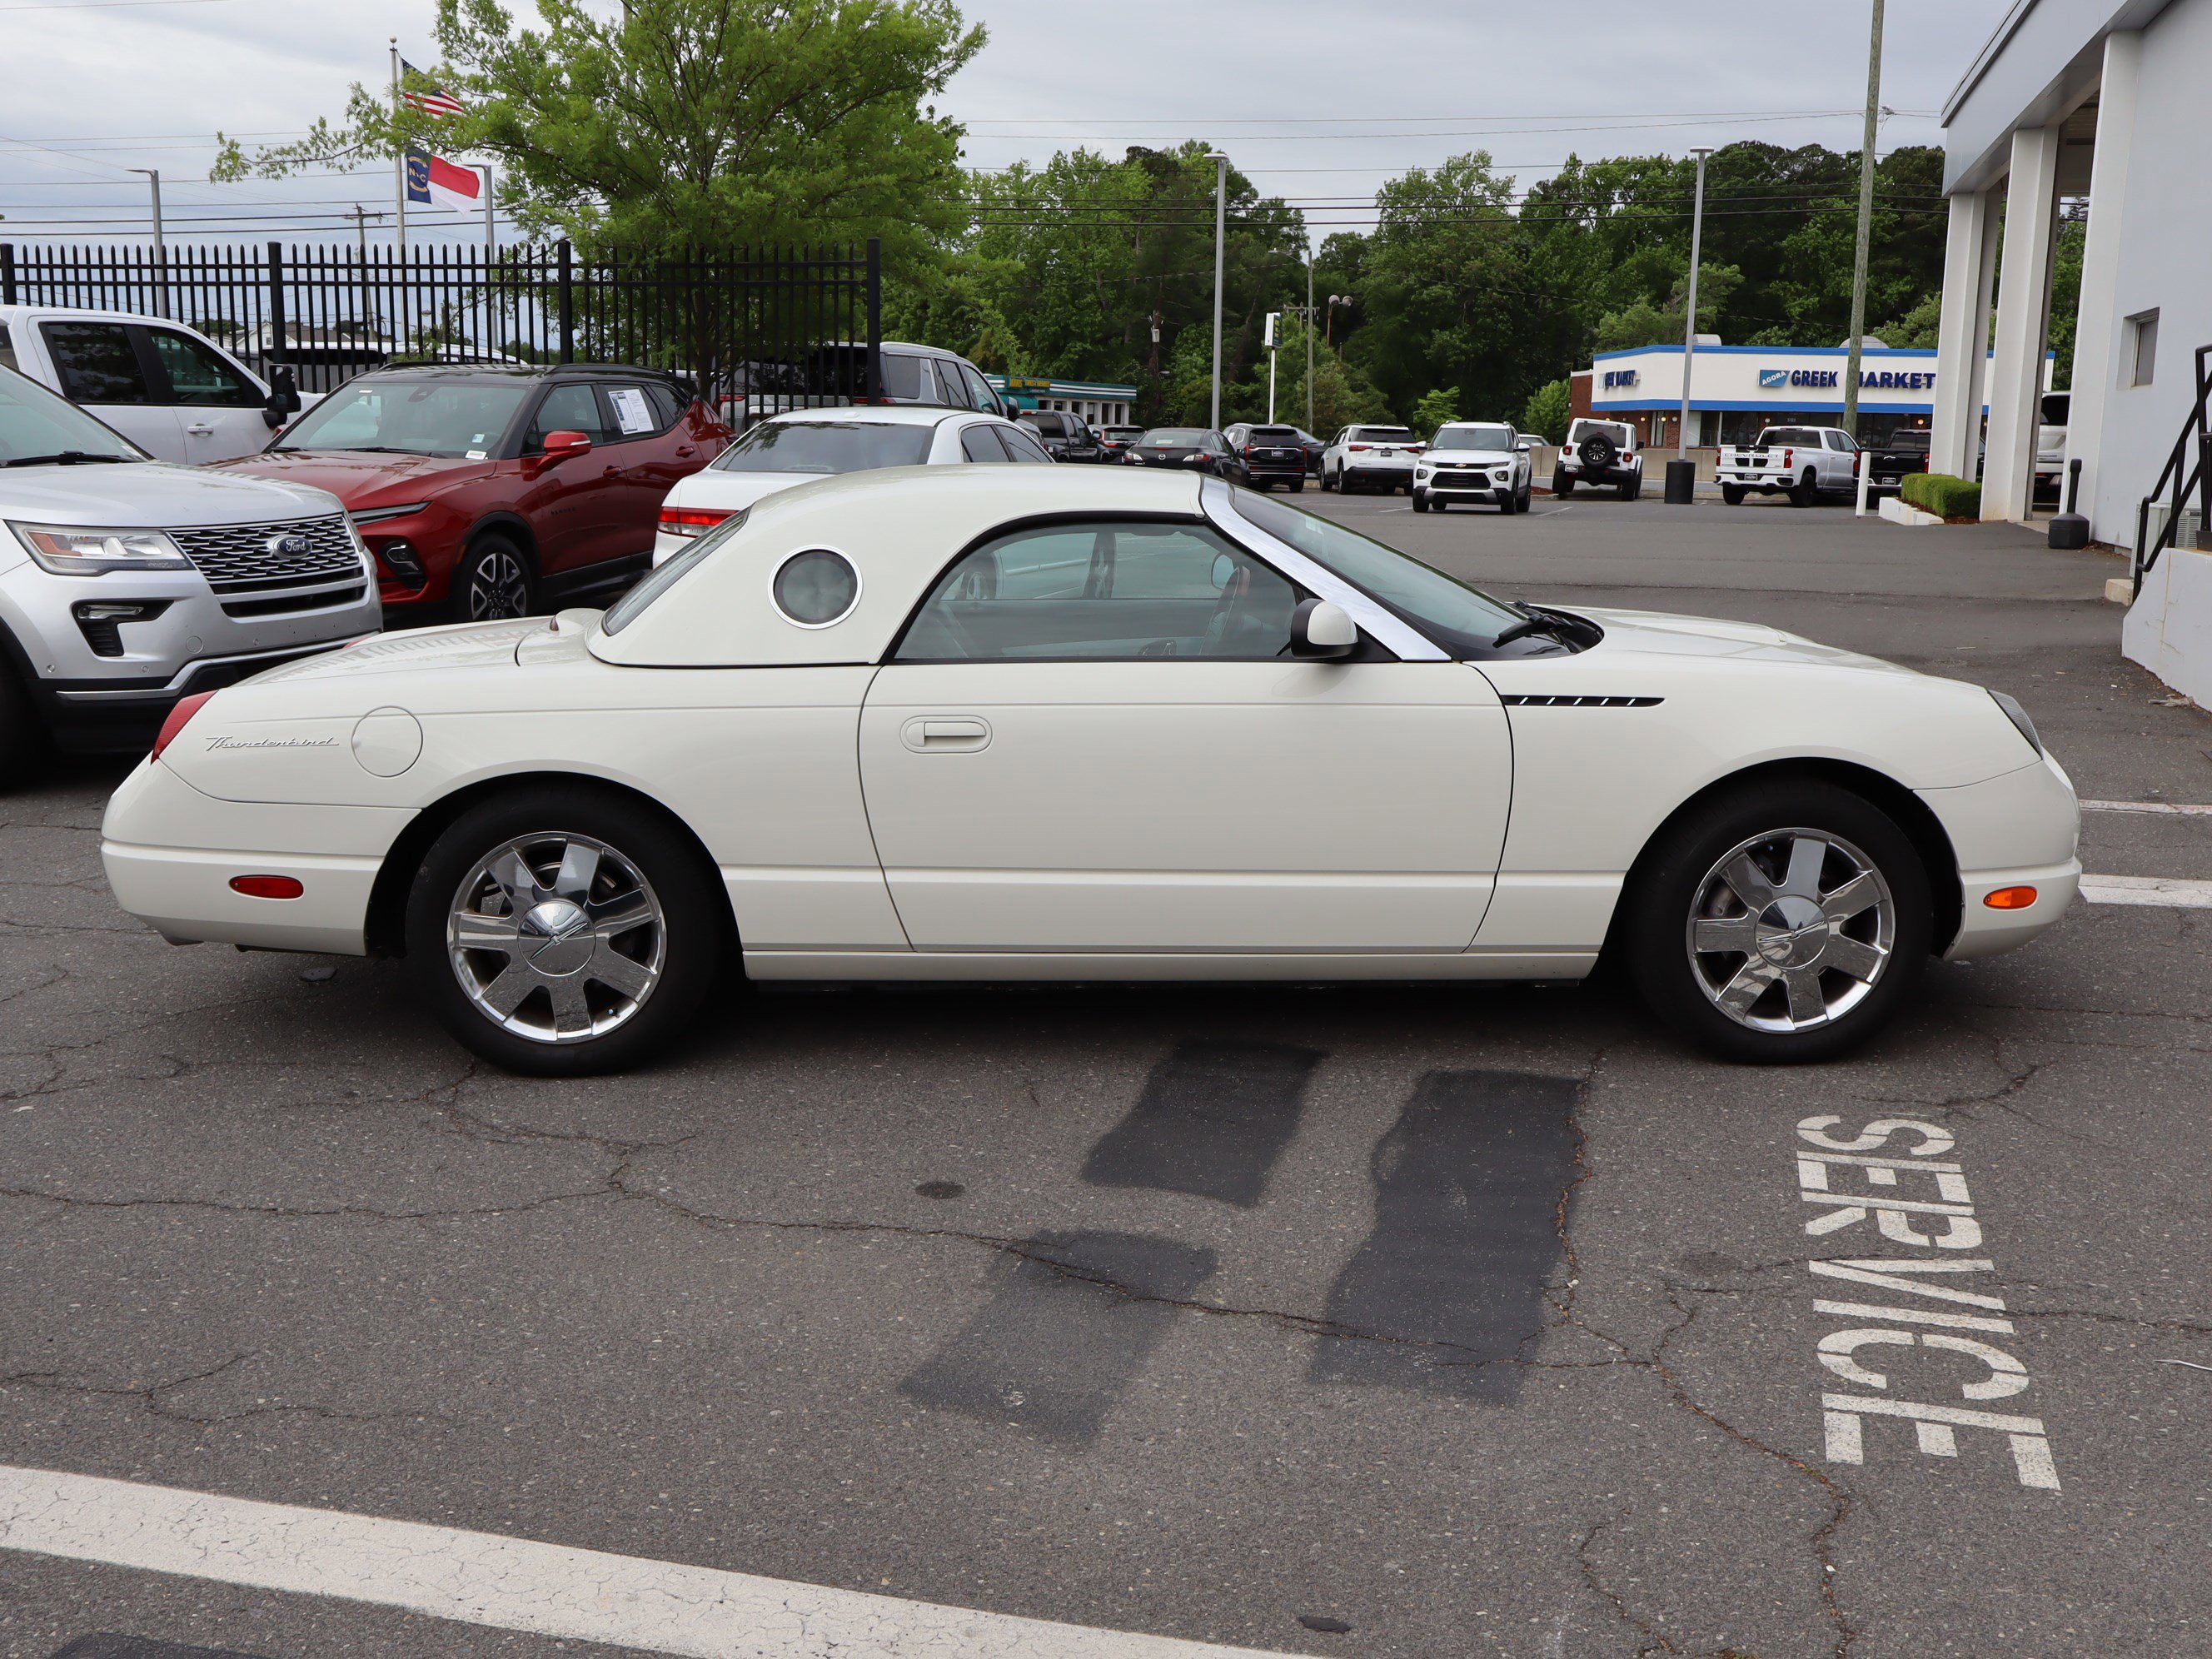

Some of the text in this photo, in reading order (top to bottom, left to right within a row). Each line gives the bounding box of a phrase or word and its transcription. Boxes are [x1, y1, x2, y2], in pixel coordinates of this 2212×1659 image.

[409, 167, 426, 182] N C
[1762, 371, 1786, 386] AGORA
[1791, 370, 1839, 387] GREEK
[286, 539, 306, 552] Ford
[206, 736, 340, 752] Thunderbird
[1796, 1114, 2062, 1491] SERVICE
